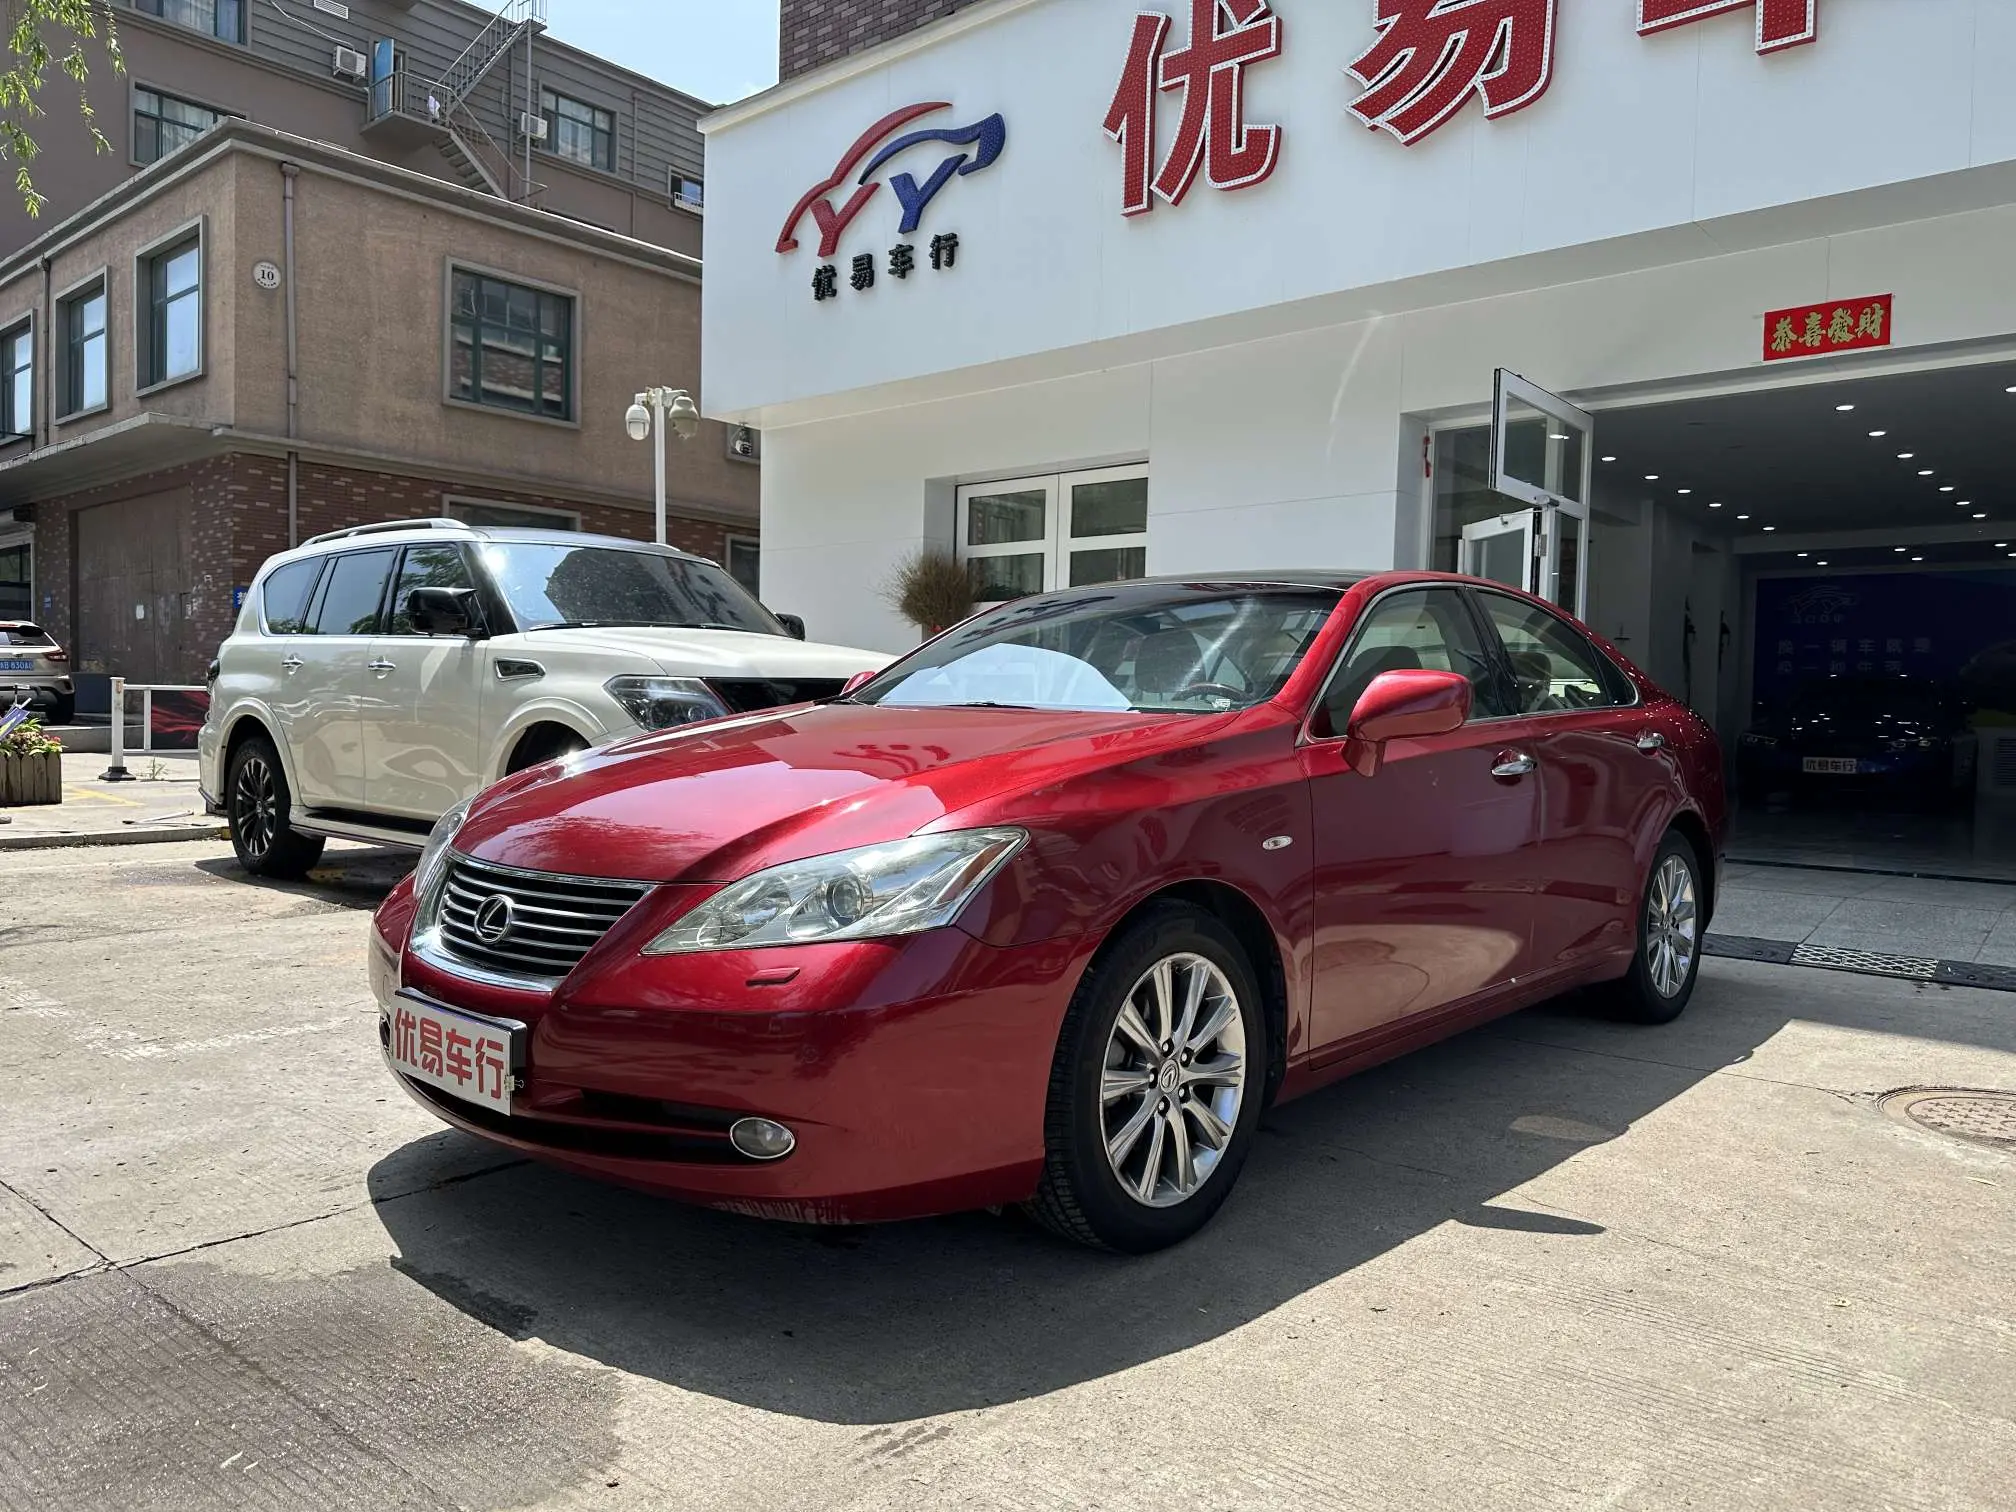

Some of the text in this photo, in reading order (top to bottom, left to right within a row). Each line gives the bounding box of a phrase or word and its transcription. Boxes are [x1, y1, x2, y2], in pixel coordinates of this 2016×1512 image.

[1103, 0, 1817, 217] 优易
[260, 270, 274, 281] 10
[811, 232, 960, 301] 优易车行
[395, 1007, 504, 1100] 优易车行
